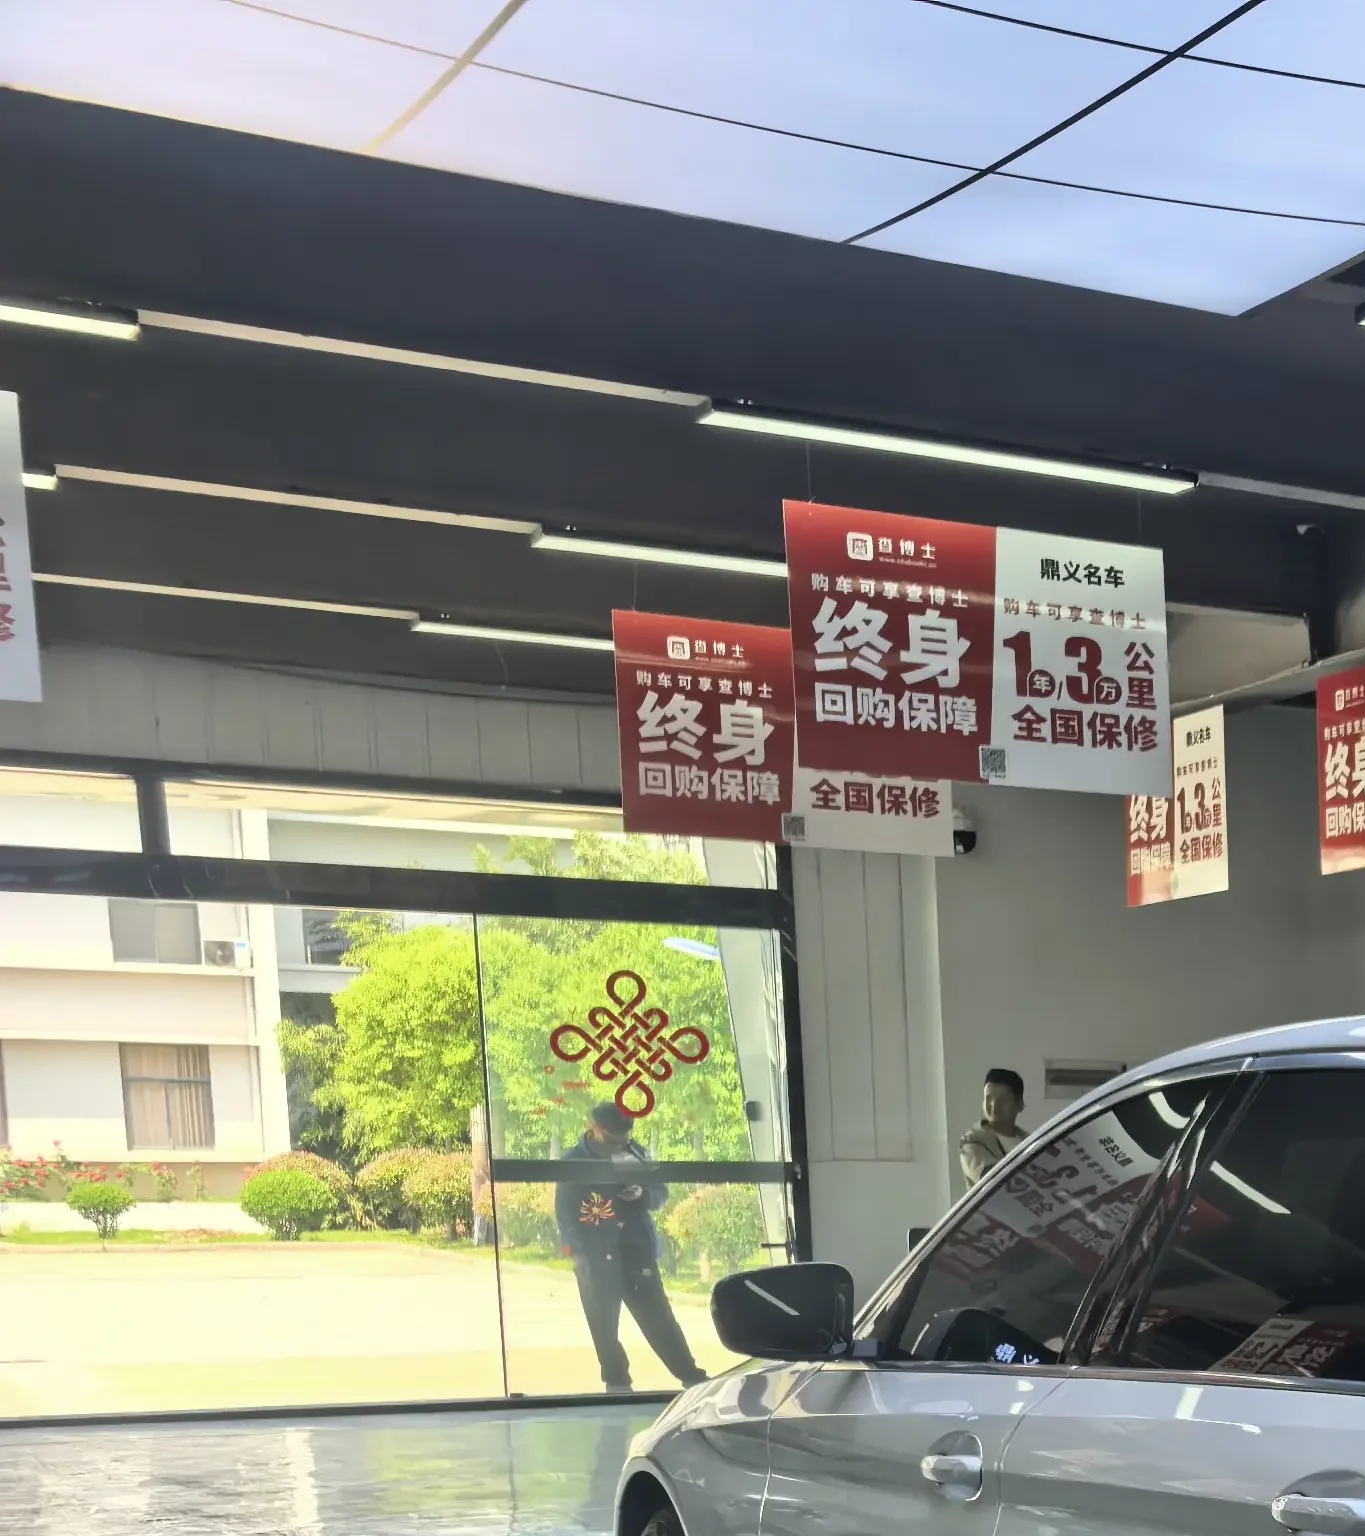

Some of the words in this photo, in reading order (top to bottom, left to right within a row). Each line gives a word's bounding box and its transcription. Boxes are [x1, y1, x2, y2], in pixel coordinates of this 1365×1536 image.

[811, 573, 969, 609] 购车可享查博士
[1039, 557, 1125, 588] 鼎义名车
[1003, 597, 1147, 630] 购车可享查博士
[812, 596, 971, 689] 终身
[636, 669, 774, 699] 购车可享查博士
[636, 689, 775, 766] 终身
[815, 682, 978, 736] 回购保障
[1013, 704, 1158, 753] 全国保修
[638, 761, 781, 806] 回购保障
[810, 778, 940, 819] 全国保修
[1130, 794, 1169, 843] 终身
[1180, 832, 1223, 864] 全国保修
